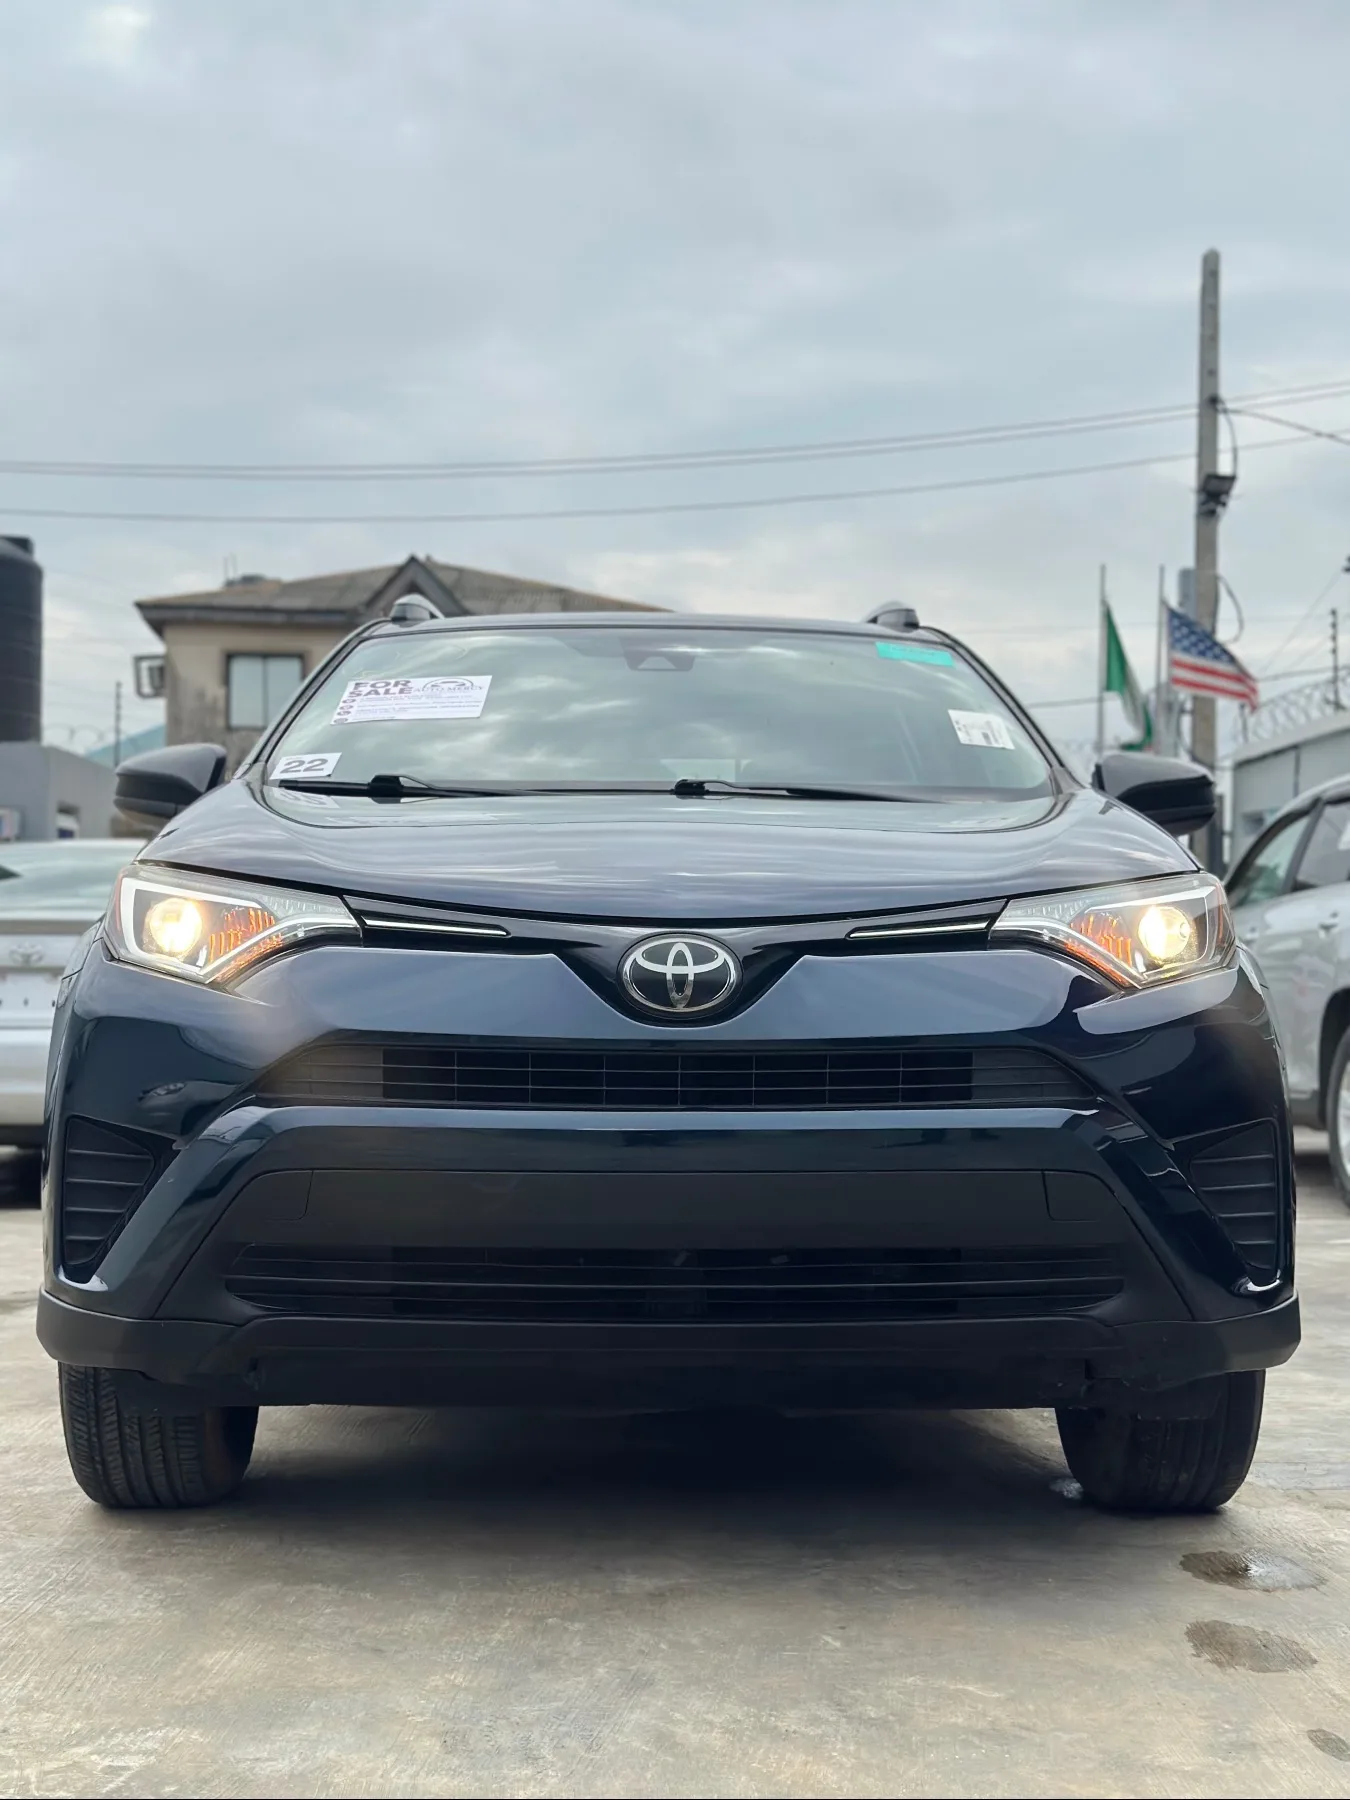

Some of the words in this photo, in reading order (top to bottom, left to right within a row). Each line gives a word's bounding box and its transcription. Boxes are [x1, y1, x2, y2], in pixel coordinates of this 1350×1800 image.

[353, 680, 411, 690] FOR
[348, 687, 414, 698] SALE
[280, 758, 329, 774] 22
